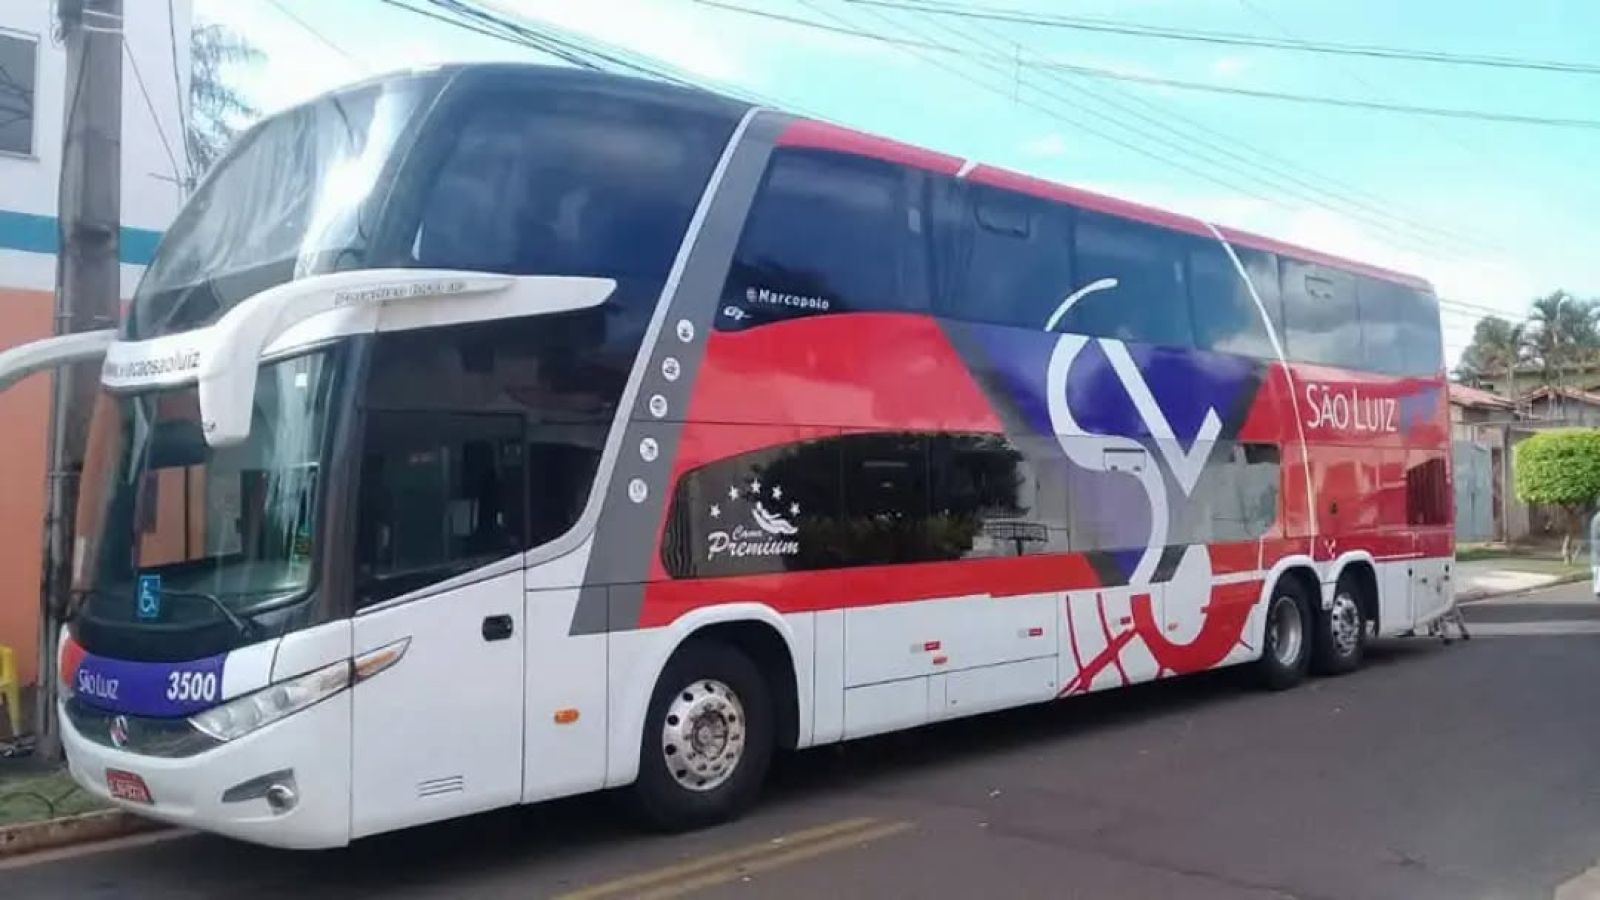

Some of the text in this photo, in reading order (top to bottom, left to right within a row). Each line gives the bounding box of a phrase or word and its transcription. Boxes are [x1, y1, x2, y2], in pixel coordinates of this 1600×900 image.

[1306, 383, 1398, 432] SÃO LUIZ
[707, 531, 799, 560] Premium
[166, 671, 216, 701] 3500
